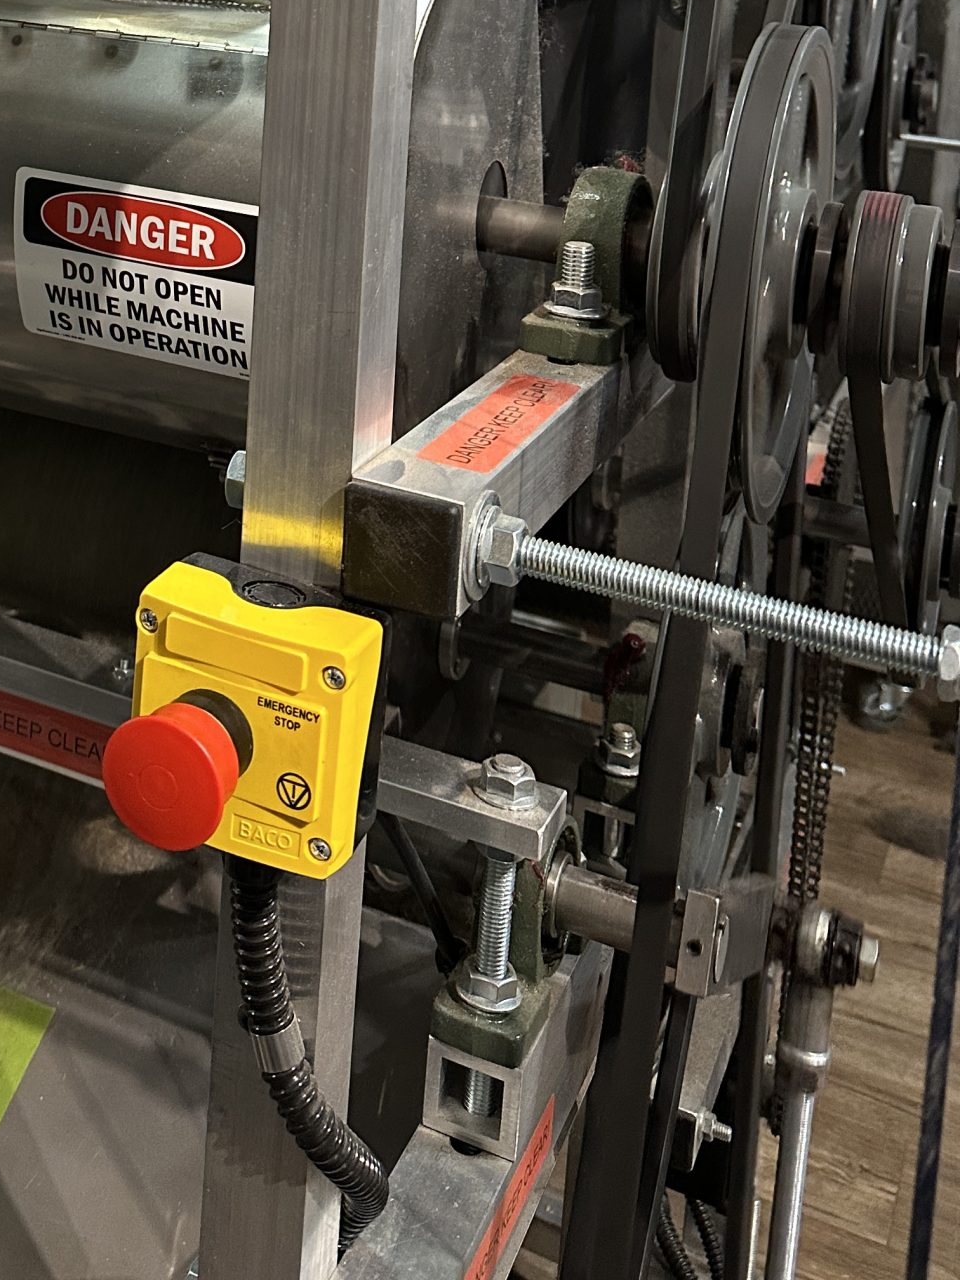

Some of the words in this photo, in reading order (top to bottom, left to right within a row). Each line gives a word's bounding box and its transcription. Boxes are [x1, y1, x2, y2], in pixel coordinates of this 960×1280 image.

[66, 201, 215, 261] DANGER
[62, 258, 95, 284] DO
[102, 266, 149, 295] NOT
[155, 277, 222, 310] OPEN
[44, 283, 121, 317] WHILE
[126, 299, 246, 343] MACHINE
[49, 310, 73, 331] IS
[78, 316, 103, 338] IN
[109, 323, 248, 370] OPERATION
[446, 422, 506, 465] DANGER
[493, 405, 527, 431] KEEP
[257, 696, 320, 724] EMERGENCY
[274, 715, 301, 732] STOP
[47, 728, 105, 761] CLEA
[239, 821, 293, 850] BACO
